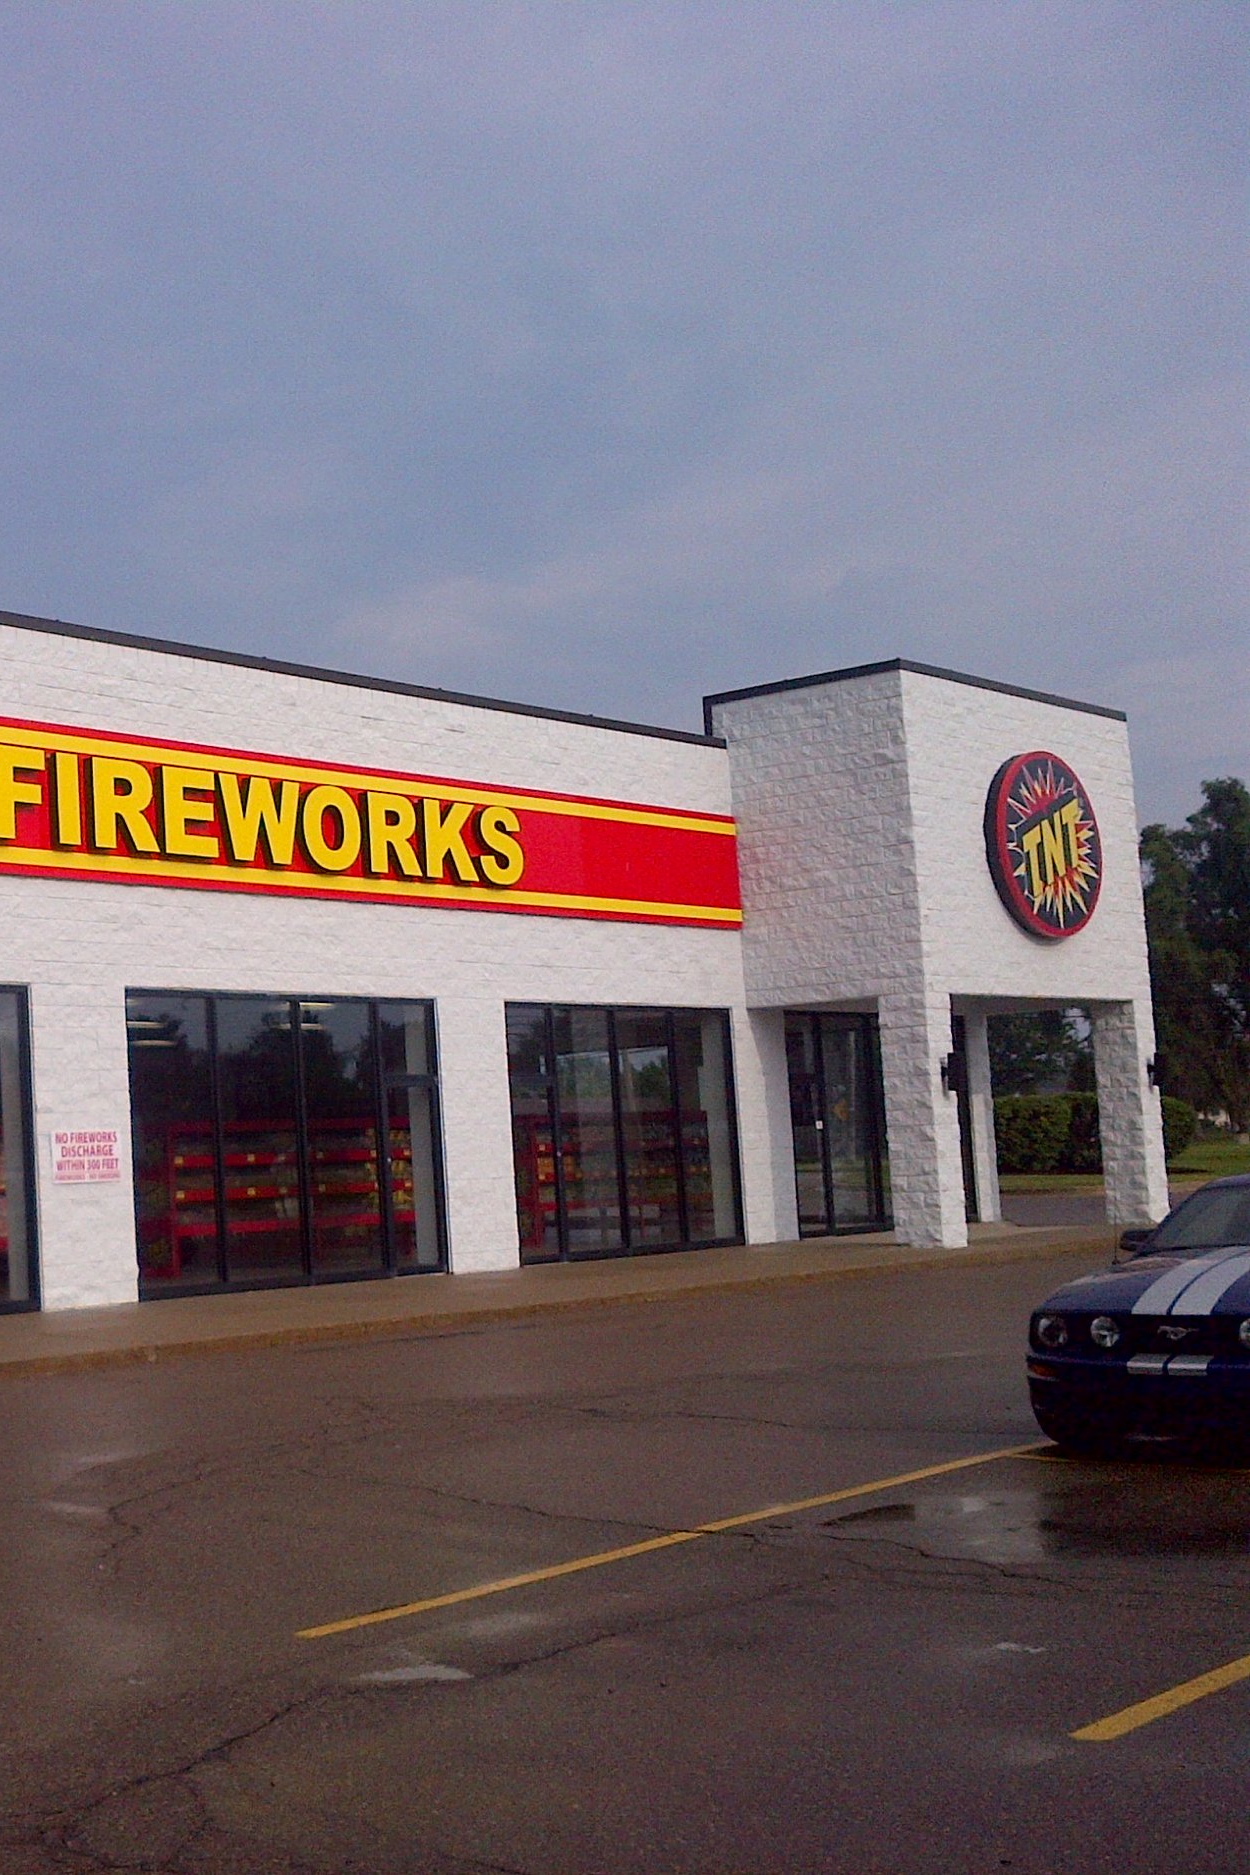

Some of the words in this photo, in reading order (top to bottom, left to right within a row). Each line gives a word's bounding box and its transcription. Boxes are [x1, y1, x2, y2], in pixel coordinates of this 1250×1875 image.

[1022, 797, 1080, 899] TNT
[55, 1132, 68, 1144] NO
[70, 1131, 117, 1144] FIREWORKS
[61, 1144, 114, 1157] DISCHARGE
[56, 1159, 85, 1171] WITHIN
[102, 1158, 119, 1169] FEET
